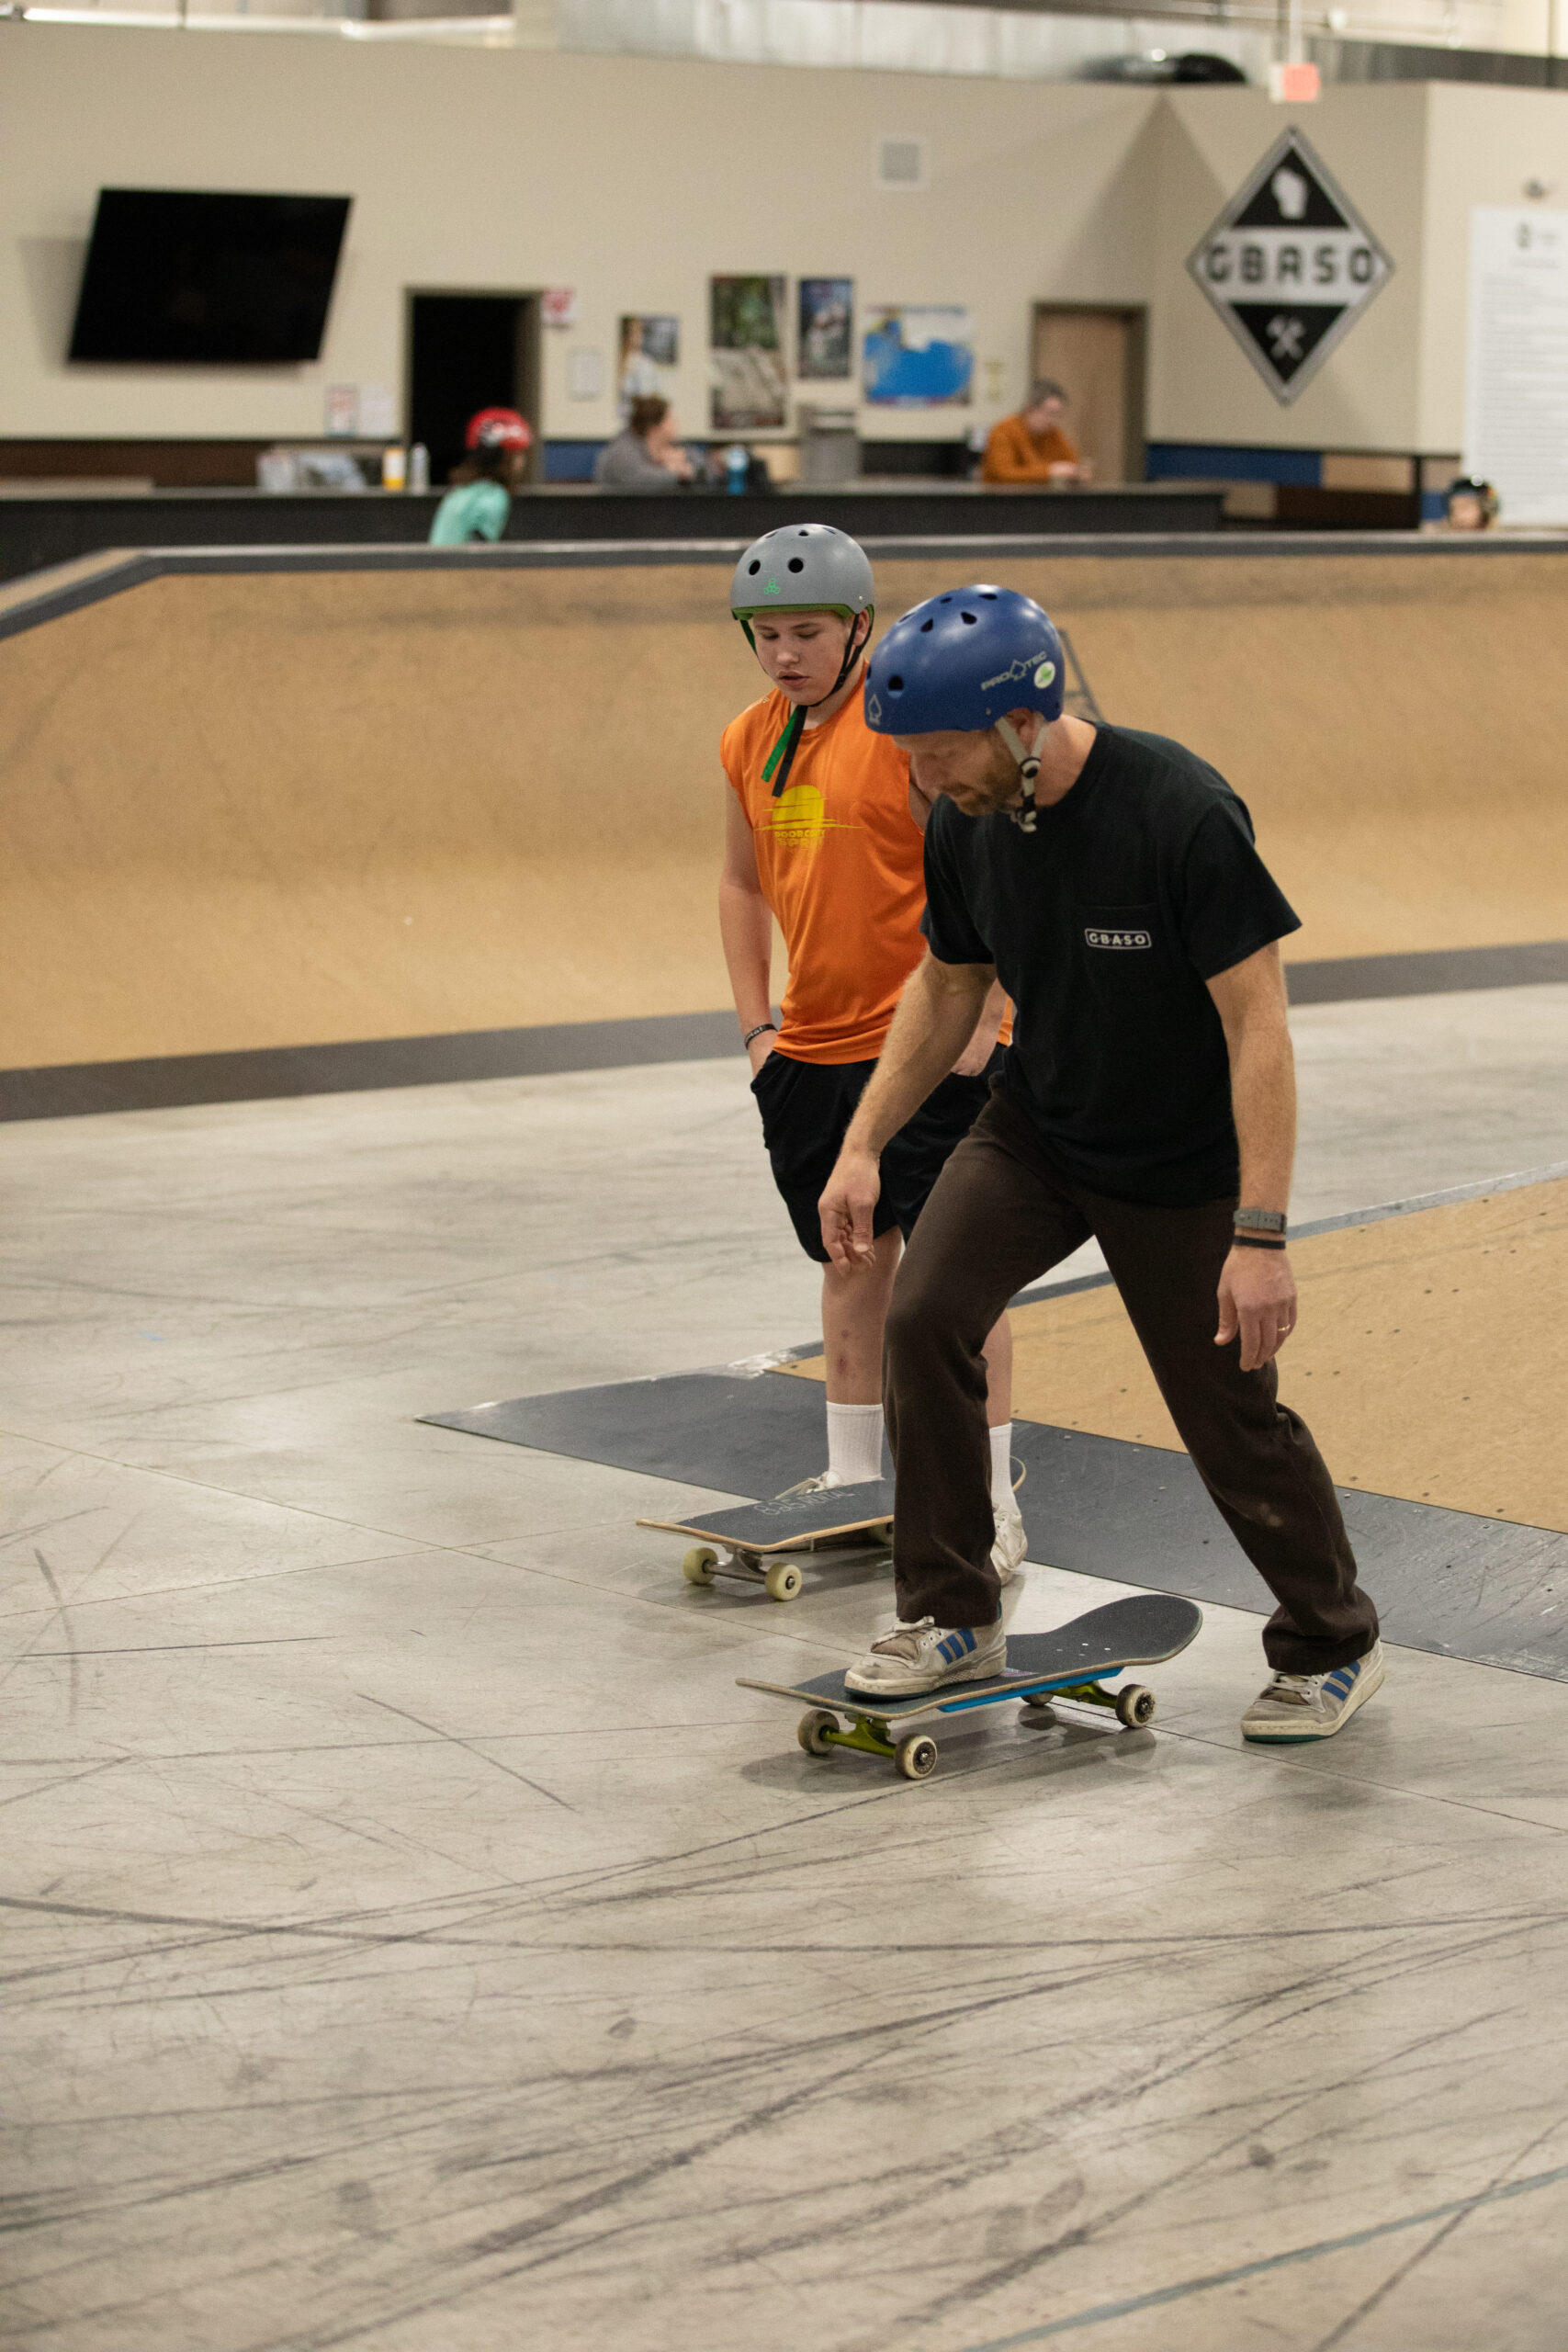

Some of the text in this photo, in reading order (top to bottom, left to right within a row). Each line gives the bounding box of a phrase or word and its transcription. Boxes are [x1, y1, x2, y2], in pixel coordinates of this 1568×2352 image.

[1206, 243, 1373, 284] GBASO
[981, 650, 1047, 691] PRO TEC
[1089, 933, 1146, 945] GBASO
